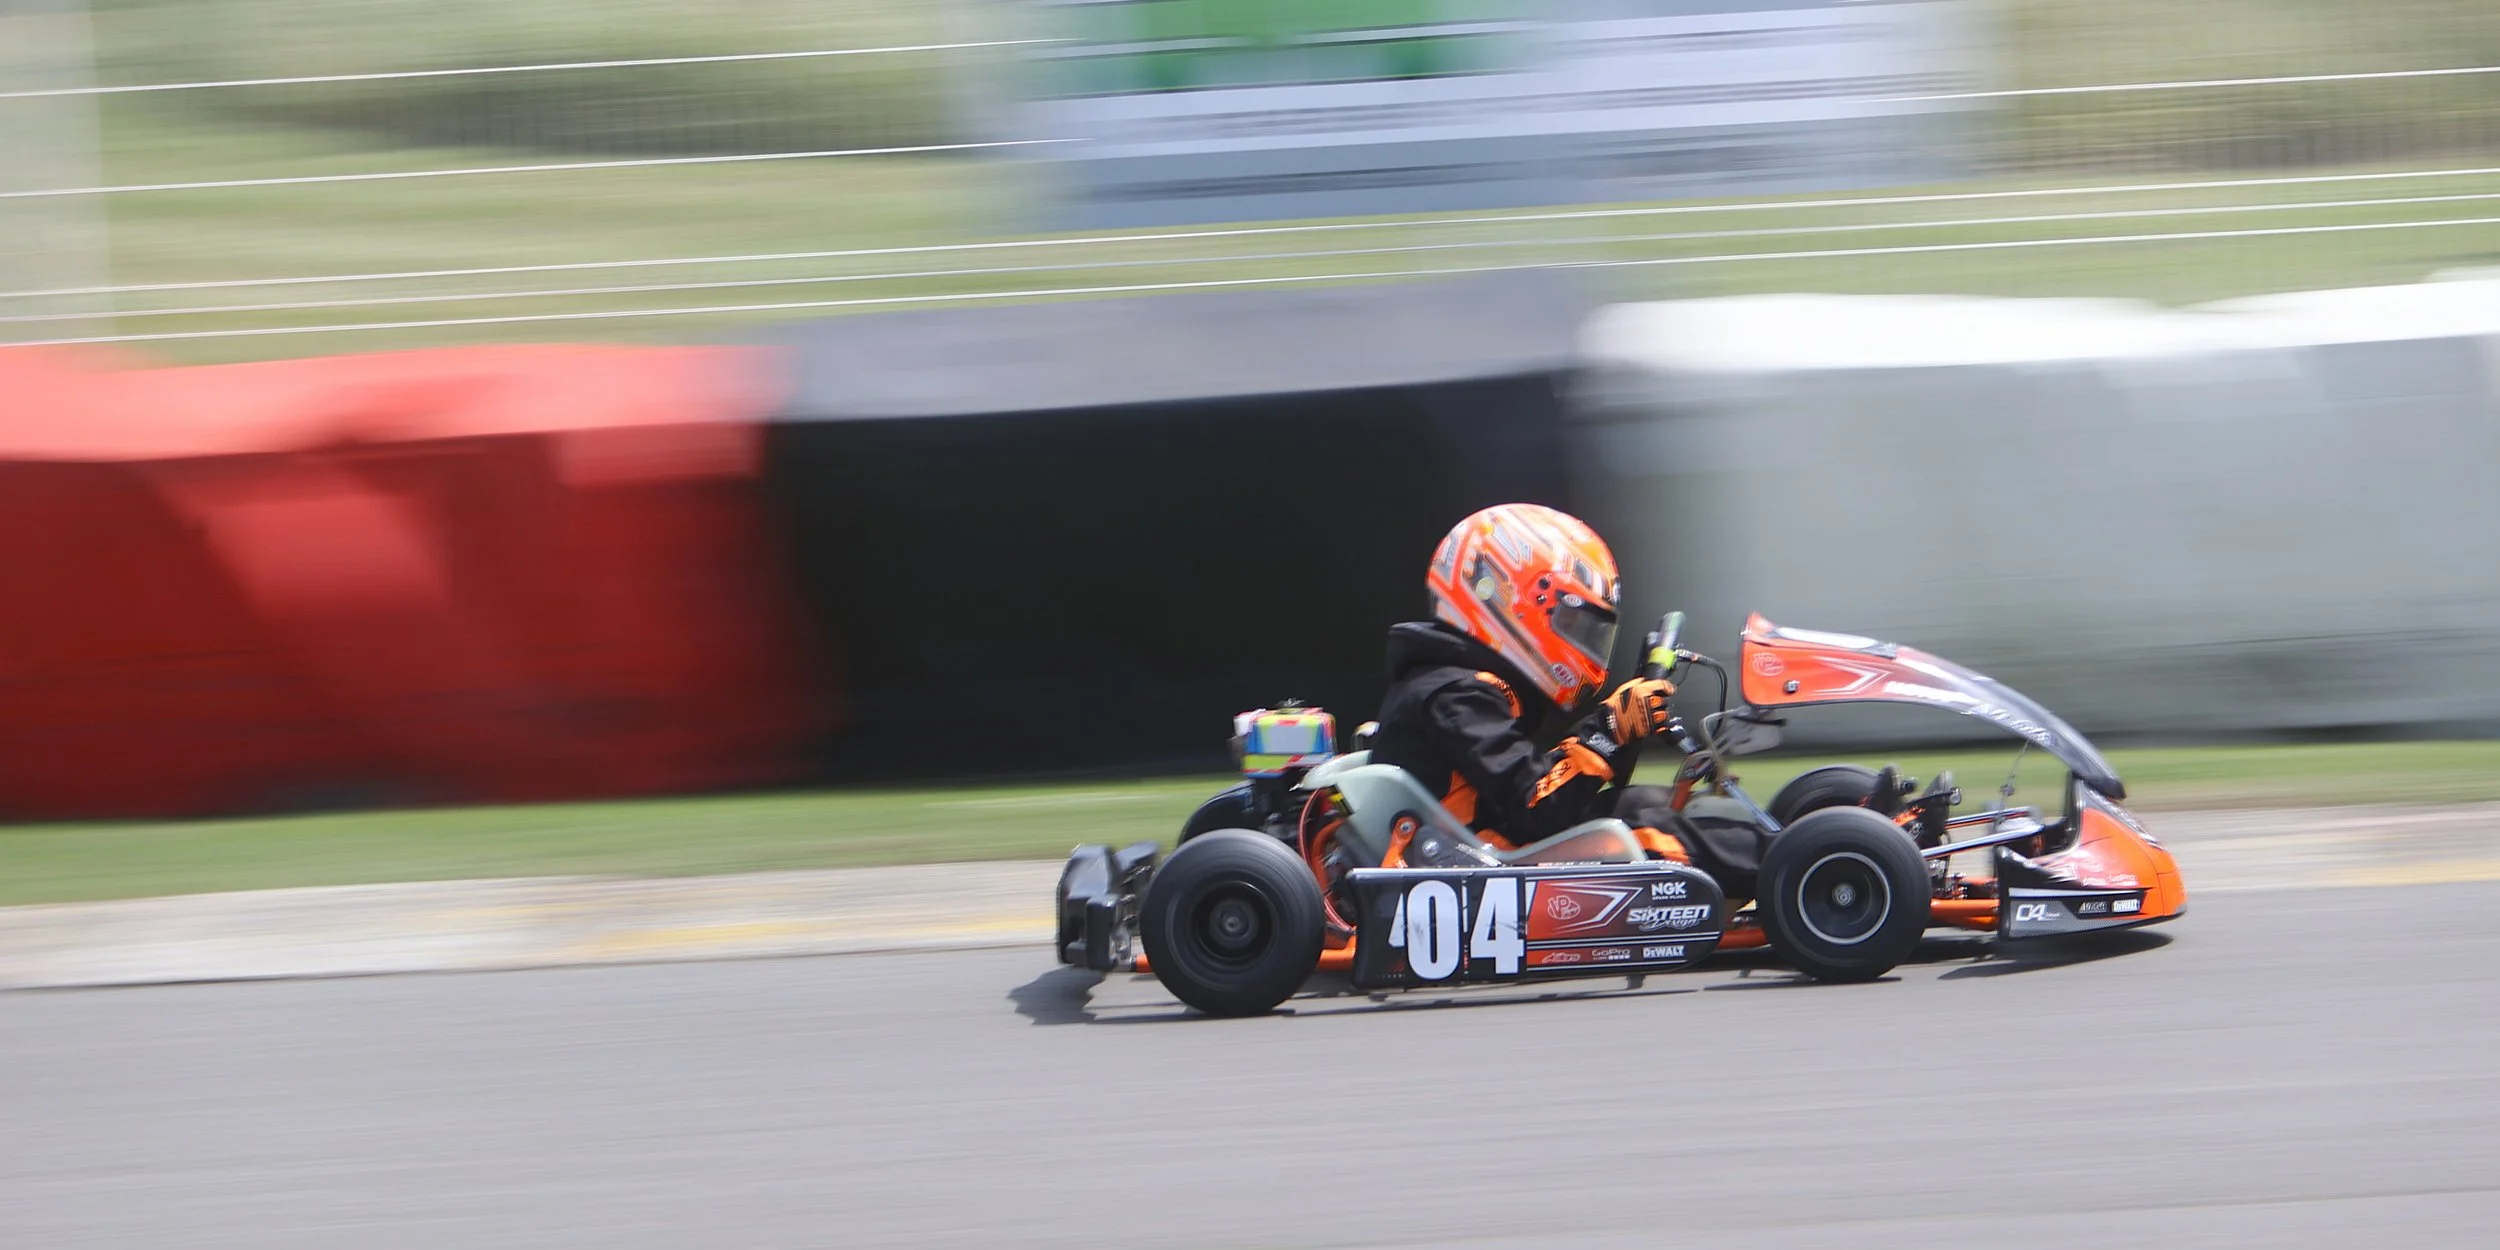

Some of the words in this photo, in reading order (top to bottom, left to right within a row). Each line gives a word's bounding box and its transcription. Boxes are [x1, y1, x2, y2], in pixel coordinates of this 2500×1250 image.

[1651, 881, 1688, 897] NGK
[2016, 904, 2048, 921] 04
[1407, 877, 1525, 980] 04
[1592, 948, 1631, 957] GoPro
[1643, 945, 1685, 958] DeWALT
